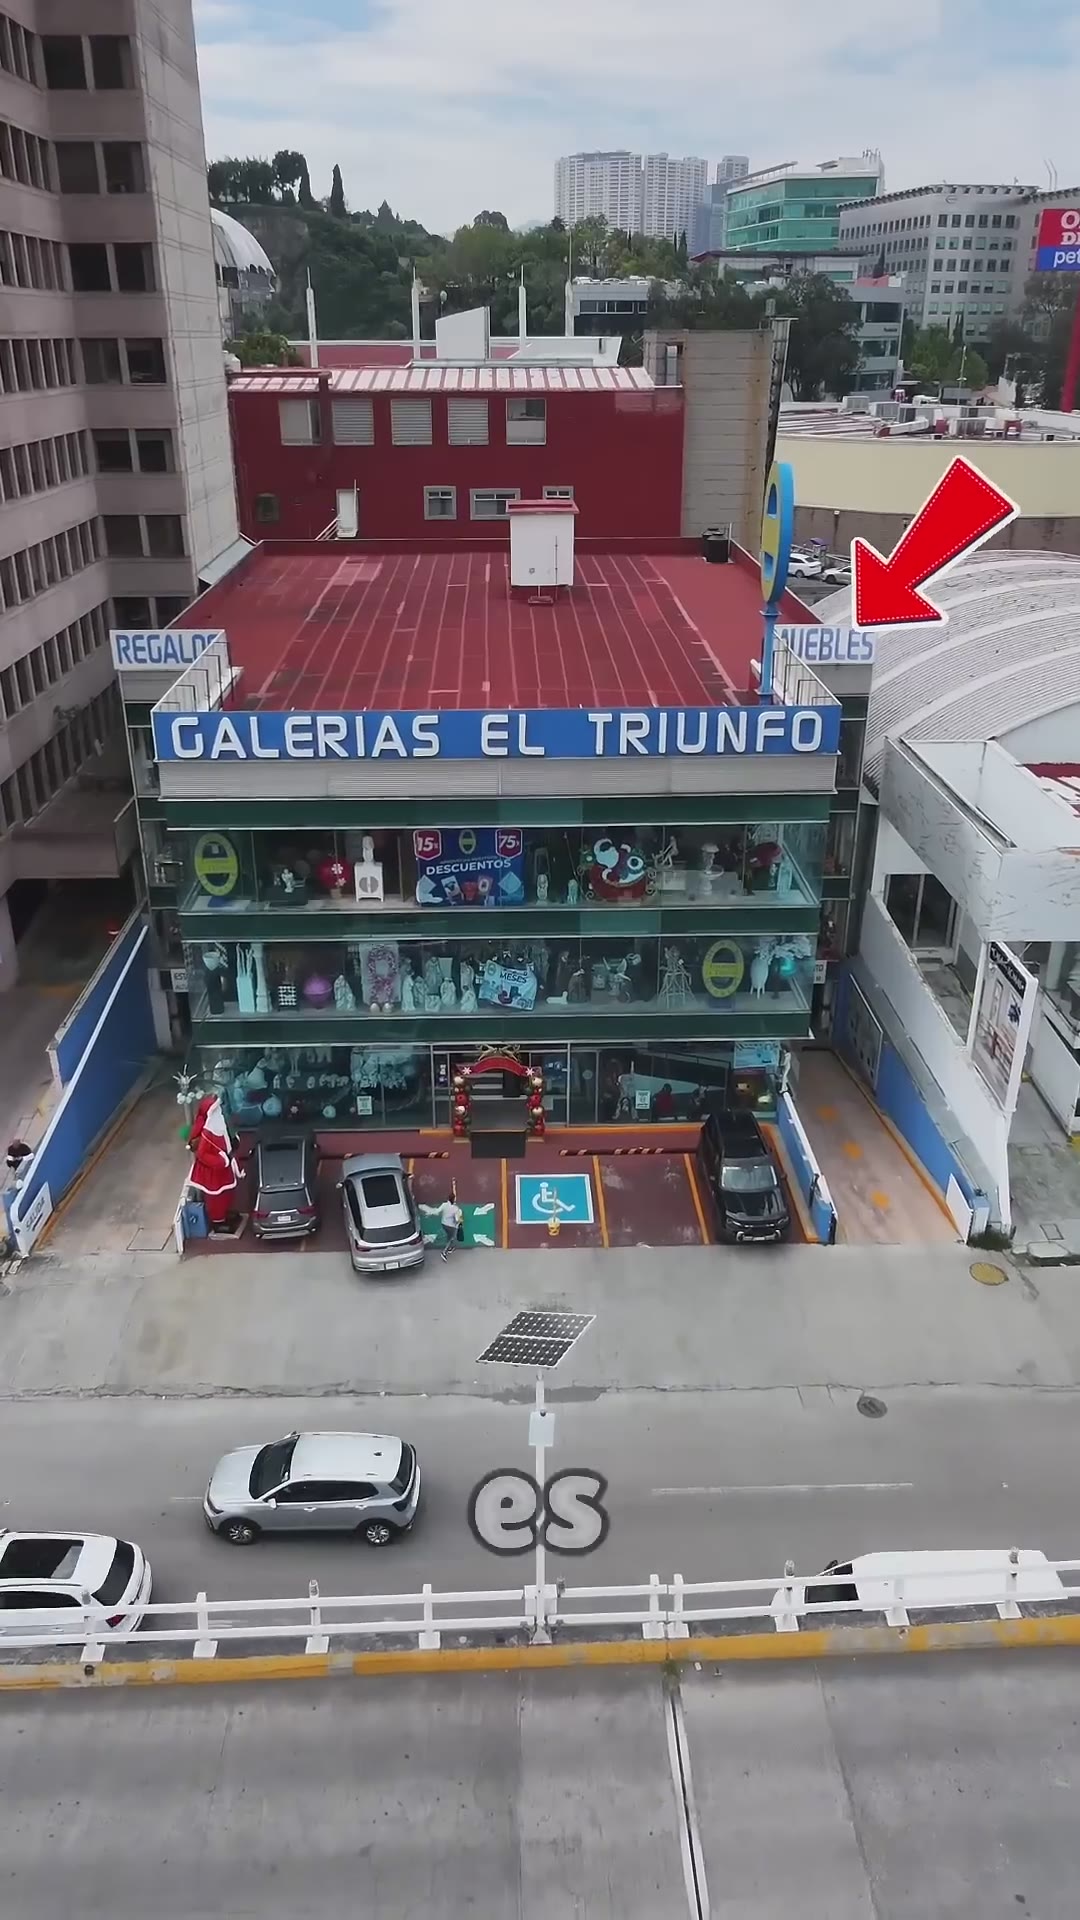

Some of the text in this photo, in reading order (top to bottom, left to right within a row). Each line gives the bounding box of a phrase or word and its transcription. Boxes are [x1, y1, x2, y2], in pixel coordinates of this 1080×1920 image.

[1060, 211, 1080, 229] O
[115, 634, 218, 664] REGALO
[171, 710, 823, 759] GALERIAS EL TRIUNFO
[426, 859, 511, 875] DESCUENTOS
[500, 970, 527, 983] MESES
